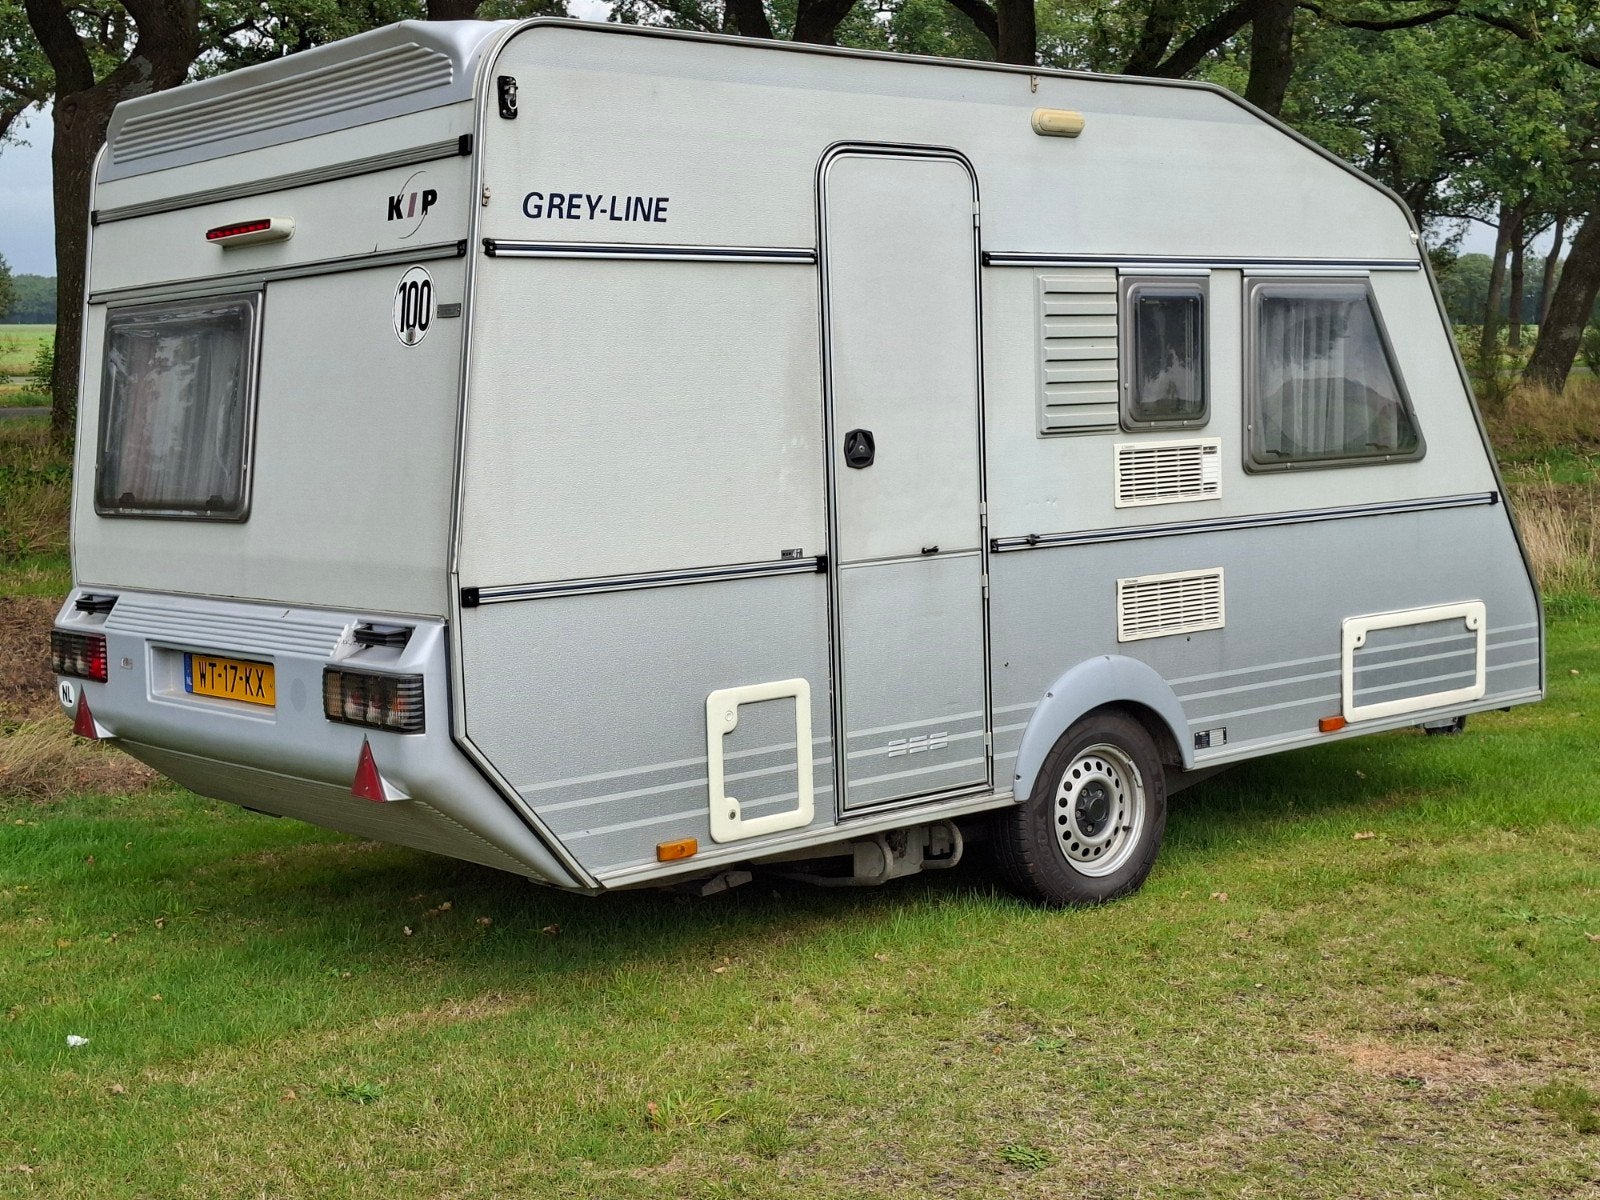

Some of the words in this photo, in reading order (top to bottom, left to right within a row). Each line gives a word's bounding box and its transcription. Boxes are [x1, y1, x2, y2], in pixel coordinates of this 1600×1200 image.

[387, 188, 438, 221] KIP
[521, 191, 670, 223] GREY-LINE
[398, 279, 432, 333] 100
[61, 684, 73, 704] NL
[198, 660, 266, 698] WT-17-KX
